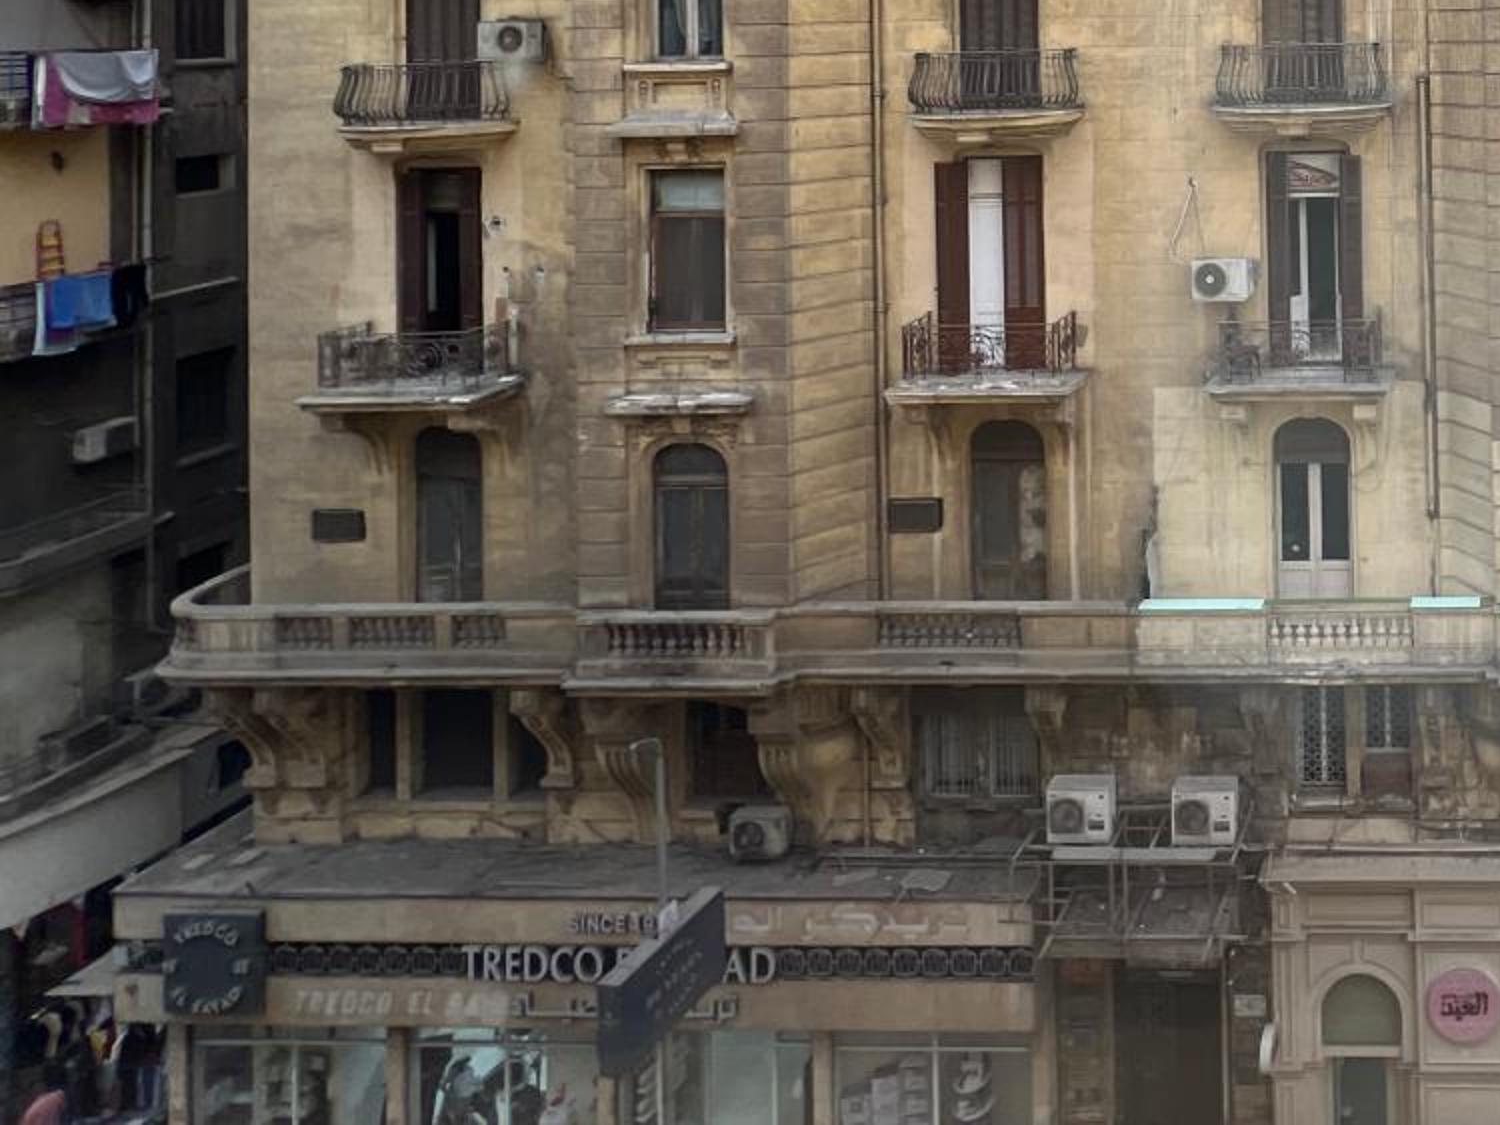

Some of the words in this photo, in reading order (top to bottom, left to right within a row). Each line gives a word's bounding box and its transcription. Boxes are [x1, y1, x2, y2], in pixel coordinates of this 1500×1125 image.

[173, 920, 240, 947] TREDCO
[568, 912, 625, 936] SINCE
[461, 943, 604, 984] TREDCO
[722, 946, 777, 984] AD
[295, 990, 394, 1016] TREDCO
[407, 992, 434, 1015] EL
[1440, 991, 1489, 1022] العبد
